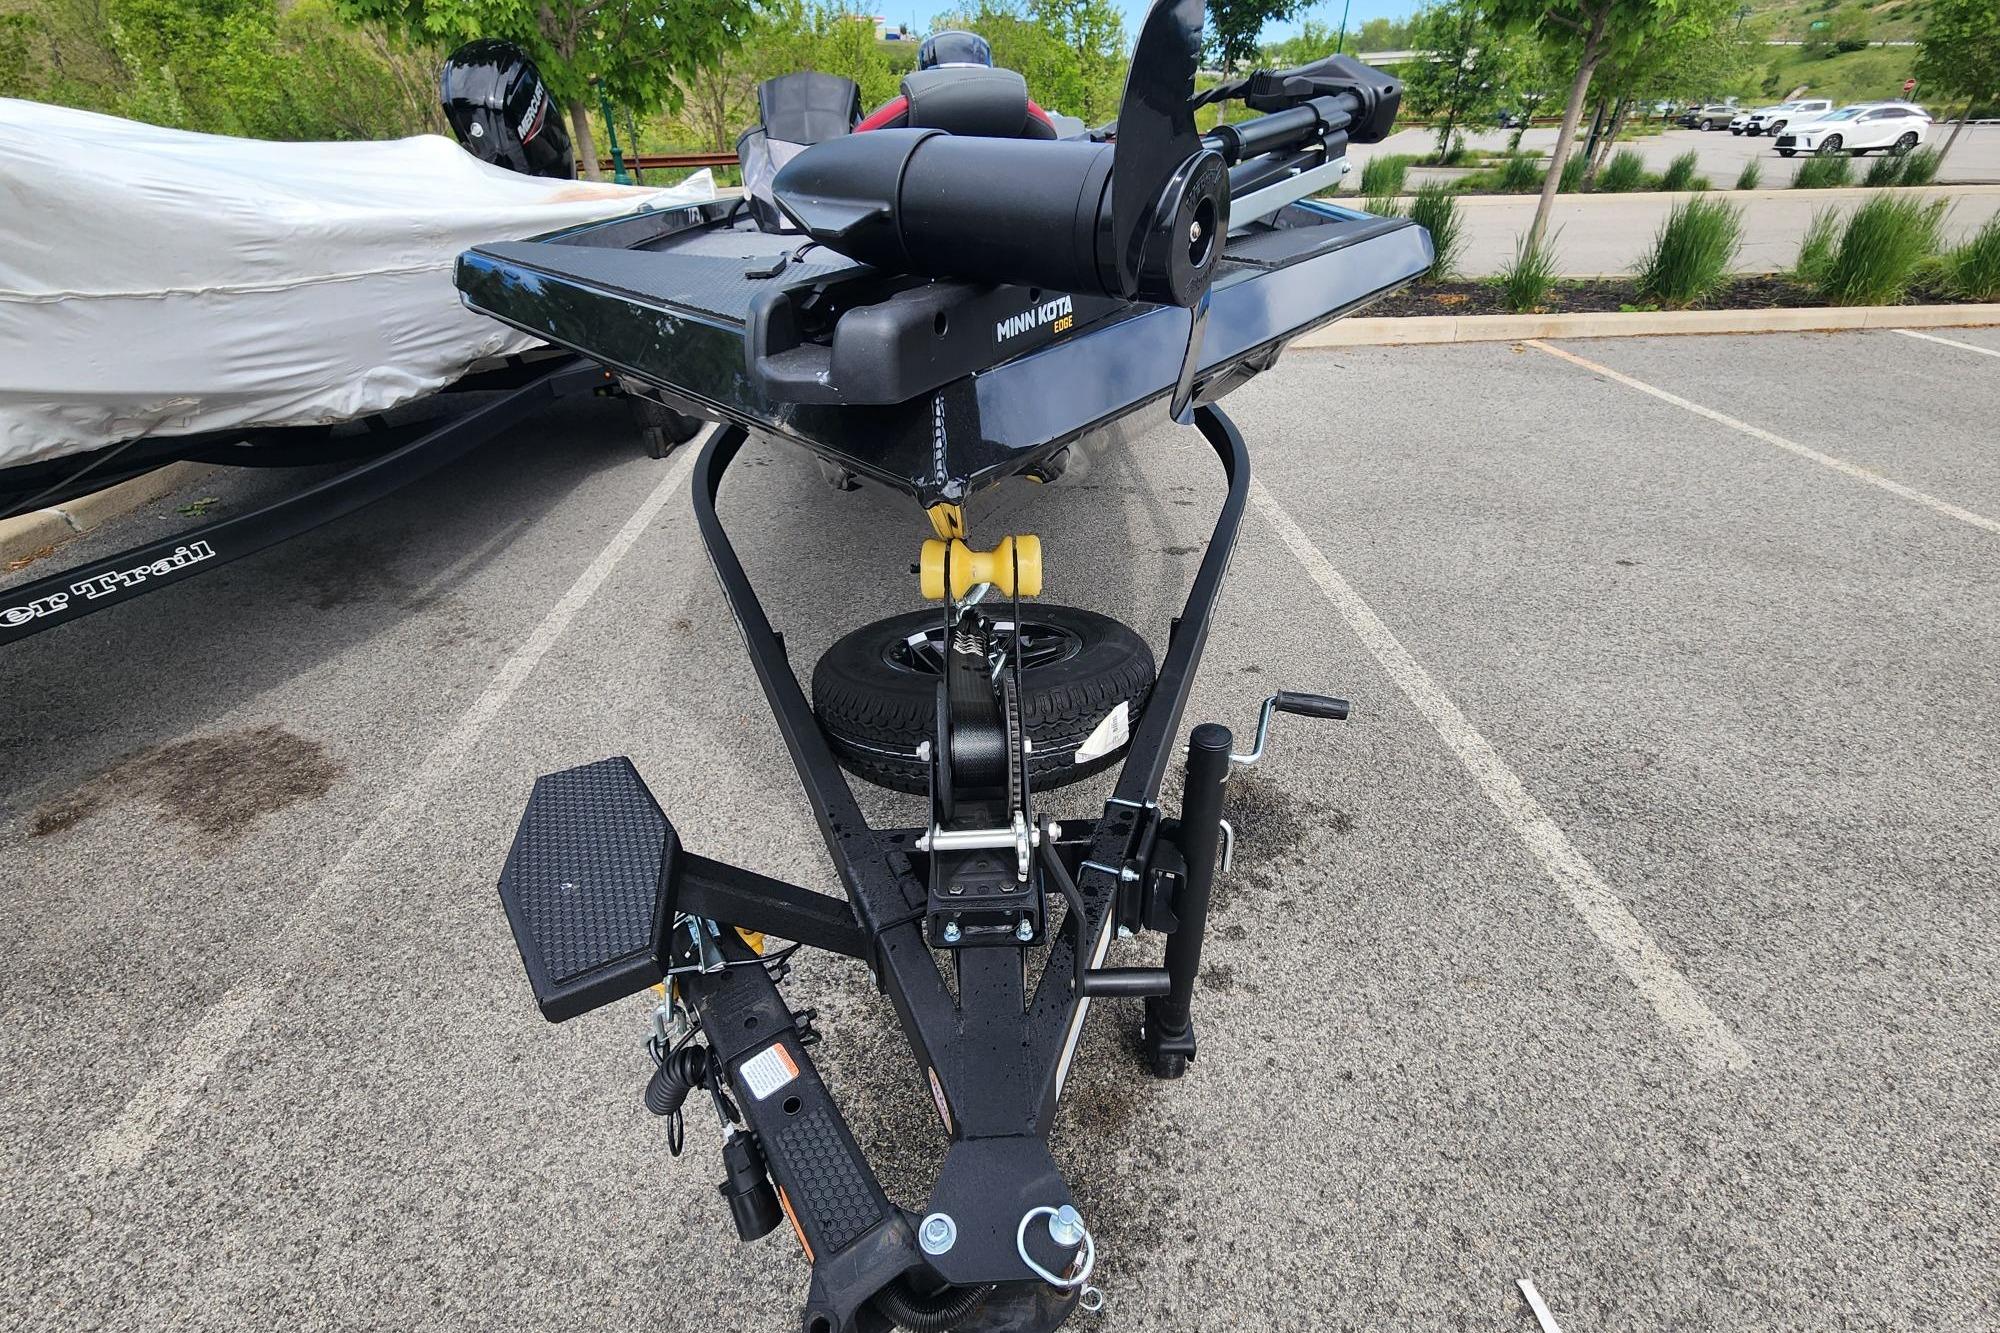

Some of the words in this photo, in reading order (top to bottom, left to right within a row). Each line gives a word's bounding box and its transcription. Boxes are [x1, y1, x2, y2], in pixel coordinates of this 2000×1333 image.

[997, 308, 1036, 343] MINN
[1037, 295, 1073, 325] KOTA
[1053, 315, 1073, 334] EDGE
[70, 540, 216, 600] Trail
